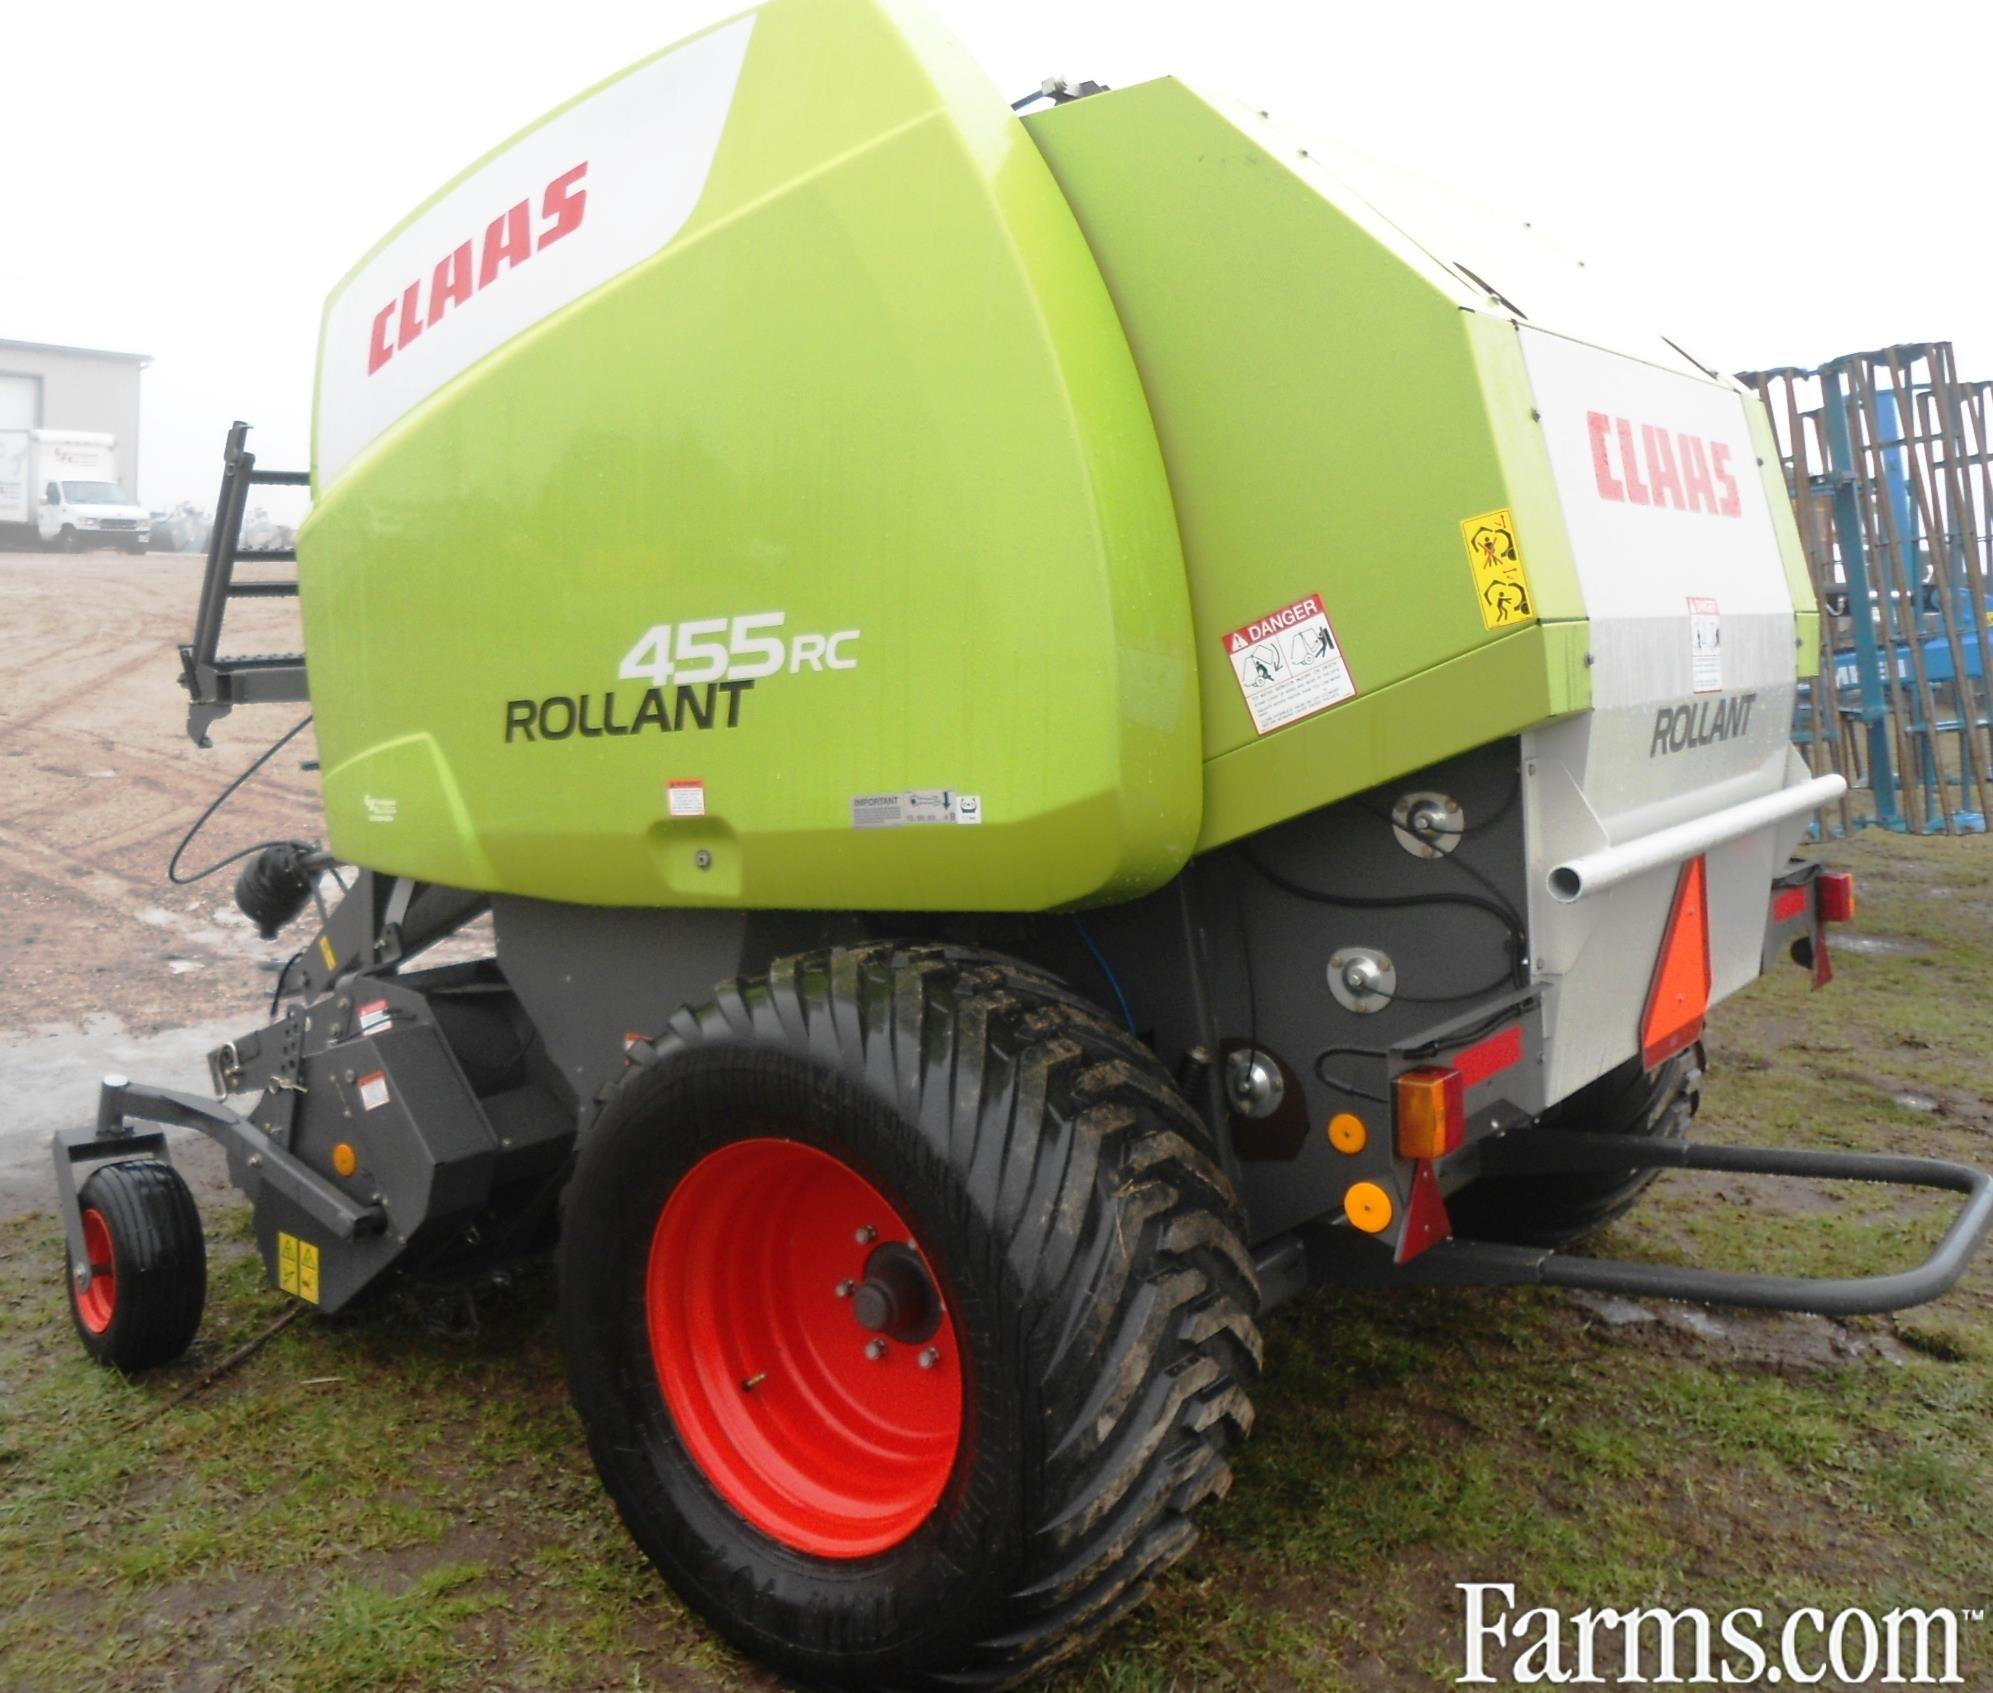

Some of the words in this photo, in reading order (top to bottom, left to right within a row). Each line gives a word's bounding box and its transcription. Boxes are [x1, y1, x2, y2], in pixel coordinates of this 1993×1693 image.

[368, 161, 588, 377] CLAAS
[1587, 411, 1741, 518] CLAAS
[618, 611, 786, 687] 455
[789, 629, 860, 674] RC
[1248, 599, 1318, 641] DANGER
[505, 679, 755, 743] ROLLANT
[1650, 694, 1757, 758] ROLLANT
[854, 796, 898, 807] IMPORTANT
